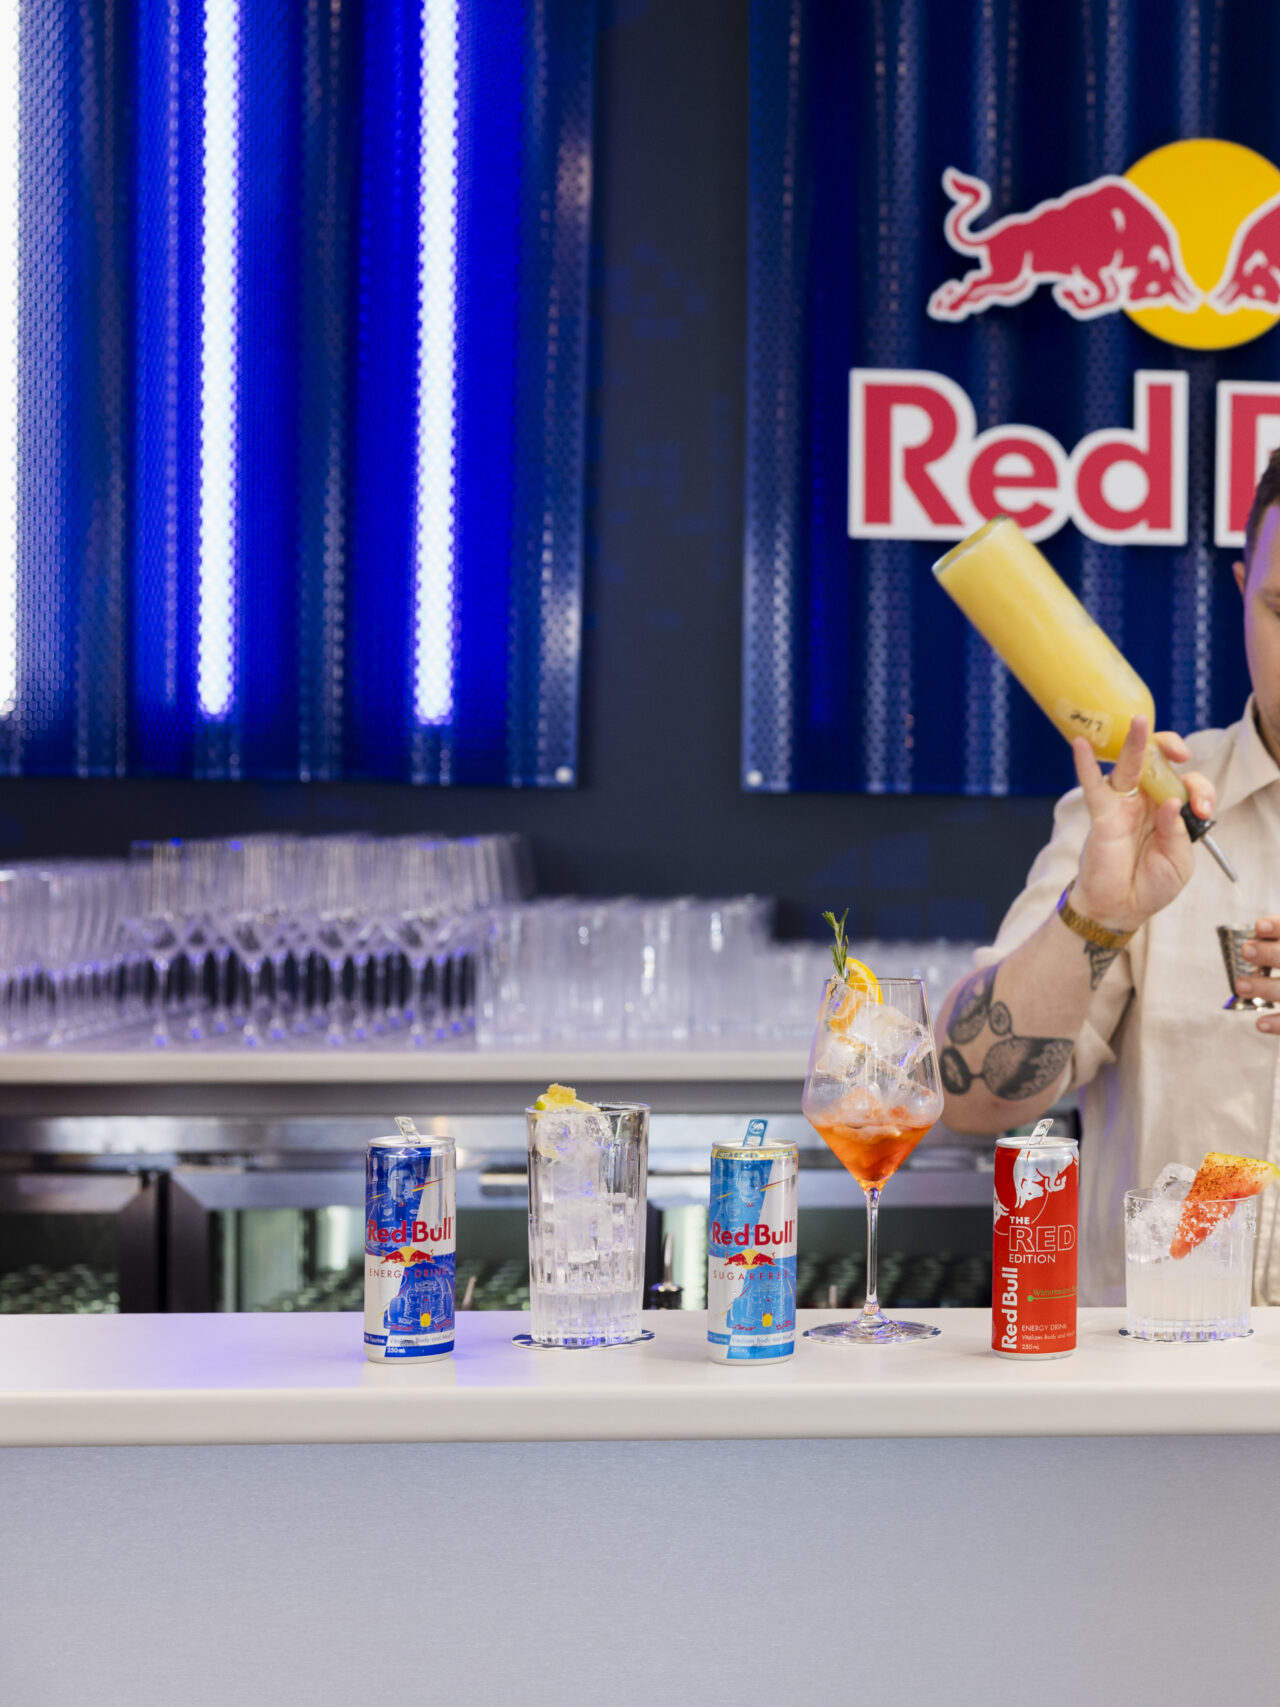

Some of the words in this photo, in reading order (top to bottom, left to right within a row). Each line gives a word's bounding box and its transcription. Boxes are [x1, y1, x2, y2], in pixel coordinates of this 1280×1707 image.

[850, 369, 1187, 545] Red
[368, 1218, 407, 1243] Red
[412, 1217, 451, 1243] Bull
[712, 1221, 750, 1246] Red
[754, 1220, 793, 1246] Bull
[1009, 1216, 1030, 1225] THE
[1008, 1224, 1076, 1252] RED
[1009, 1253, 1056, 1264] EDITION
[369, 1268, 410, 1278] ENERGY
[414, 1267, 448, 1278] DRINK
[713, 1270, 788, 1281] SUGARFREE
[1001, 1267, 1019, 1307] Bull
[1001, 1308, 1018, 1350] Red
[1021, 1324, 1048, 1332] ENERGY
[1050, 1323, 1067, 1331] DRINK
